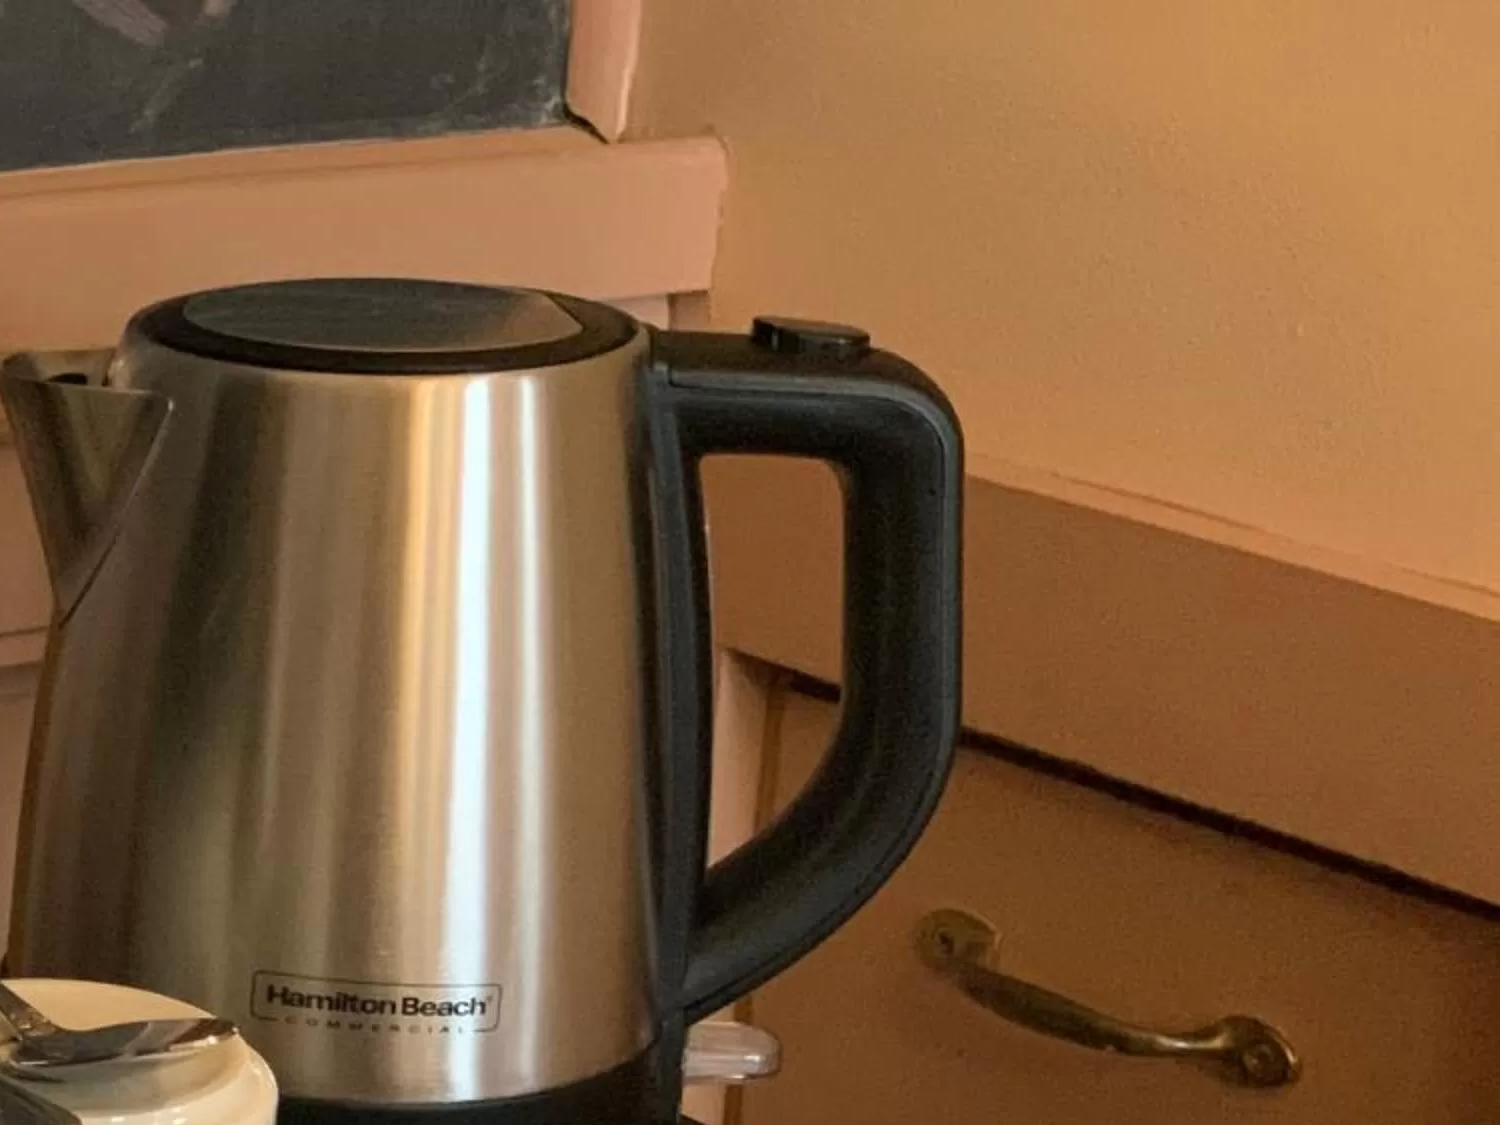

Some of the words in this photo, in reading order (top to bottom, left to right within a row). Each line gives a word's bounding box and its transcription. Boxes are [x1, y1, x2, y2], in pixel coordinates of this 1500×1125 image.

[267, 984, 396, 1015] Hamilton
[400, 996, 487, 1017] Beach
[284, 1016, 467, 1034] COMMERCIAL
